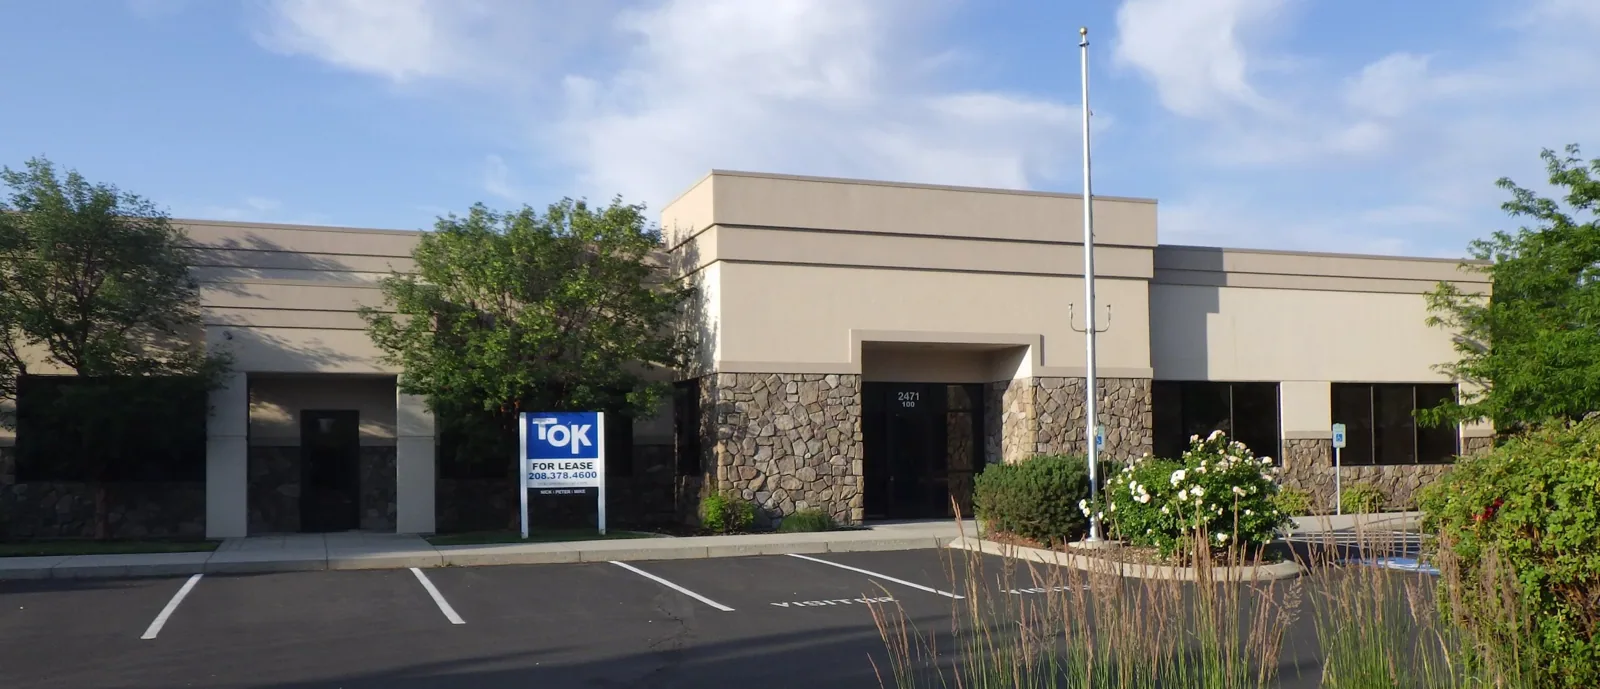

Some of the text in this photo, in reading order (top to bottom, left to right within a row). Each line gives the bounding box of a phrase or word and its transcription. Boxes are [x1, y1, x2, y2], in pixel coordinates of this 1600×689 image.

[897, 391, 920, 401] 2471
[532, 461, 594, 471] FOR LEASE
[528, 471, 598, 480] 208.378.4600
[770, 596, 895, 608] VISITOR
